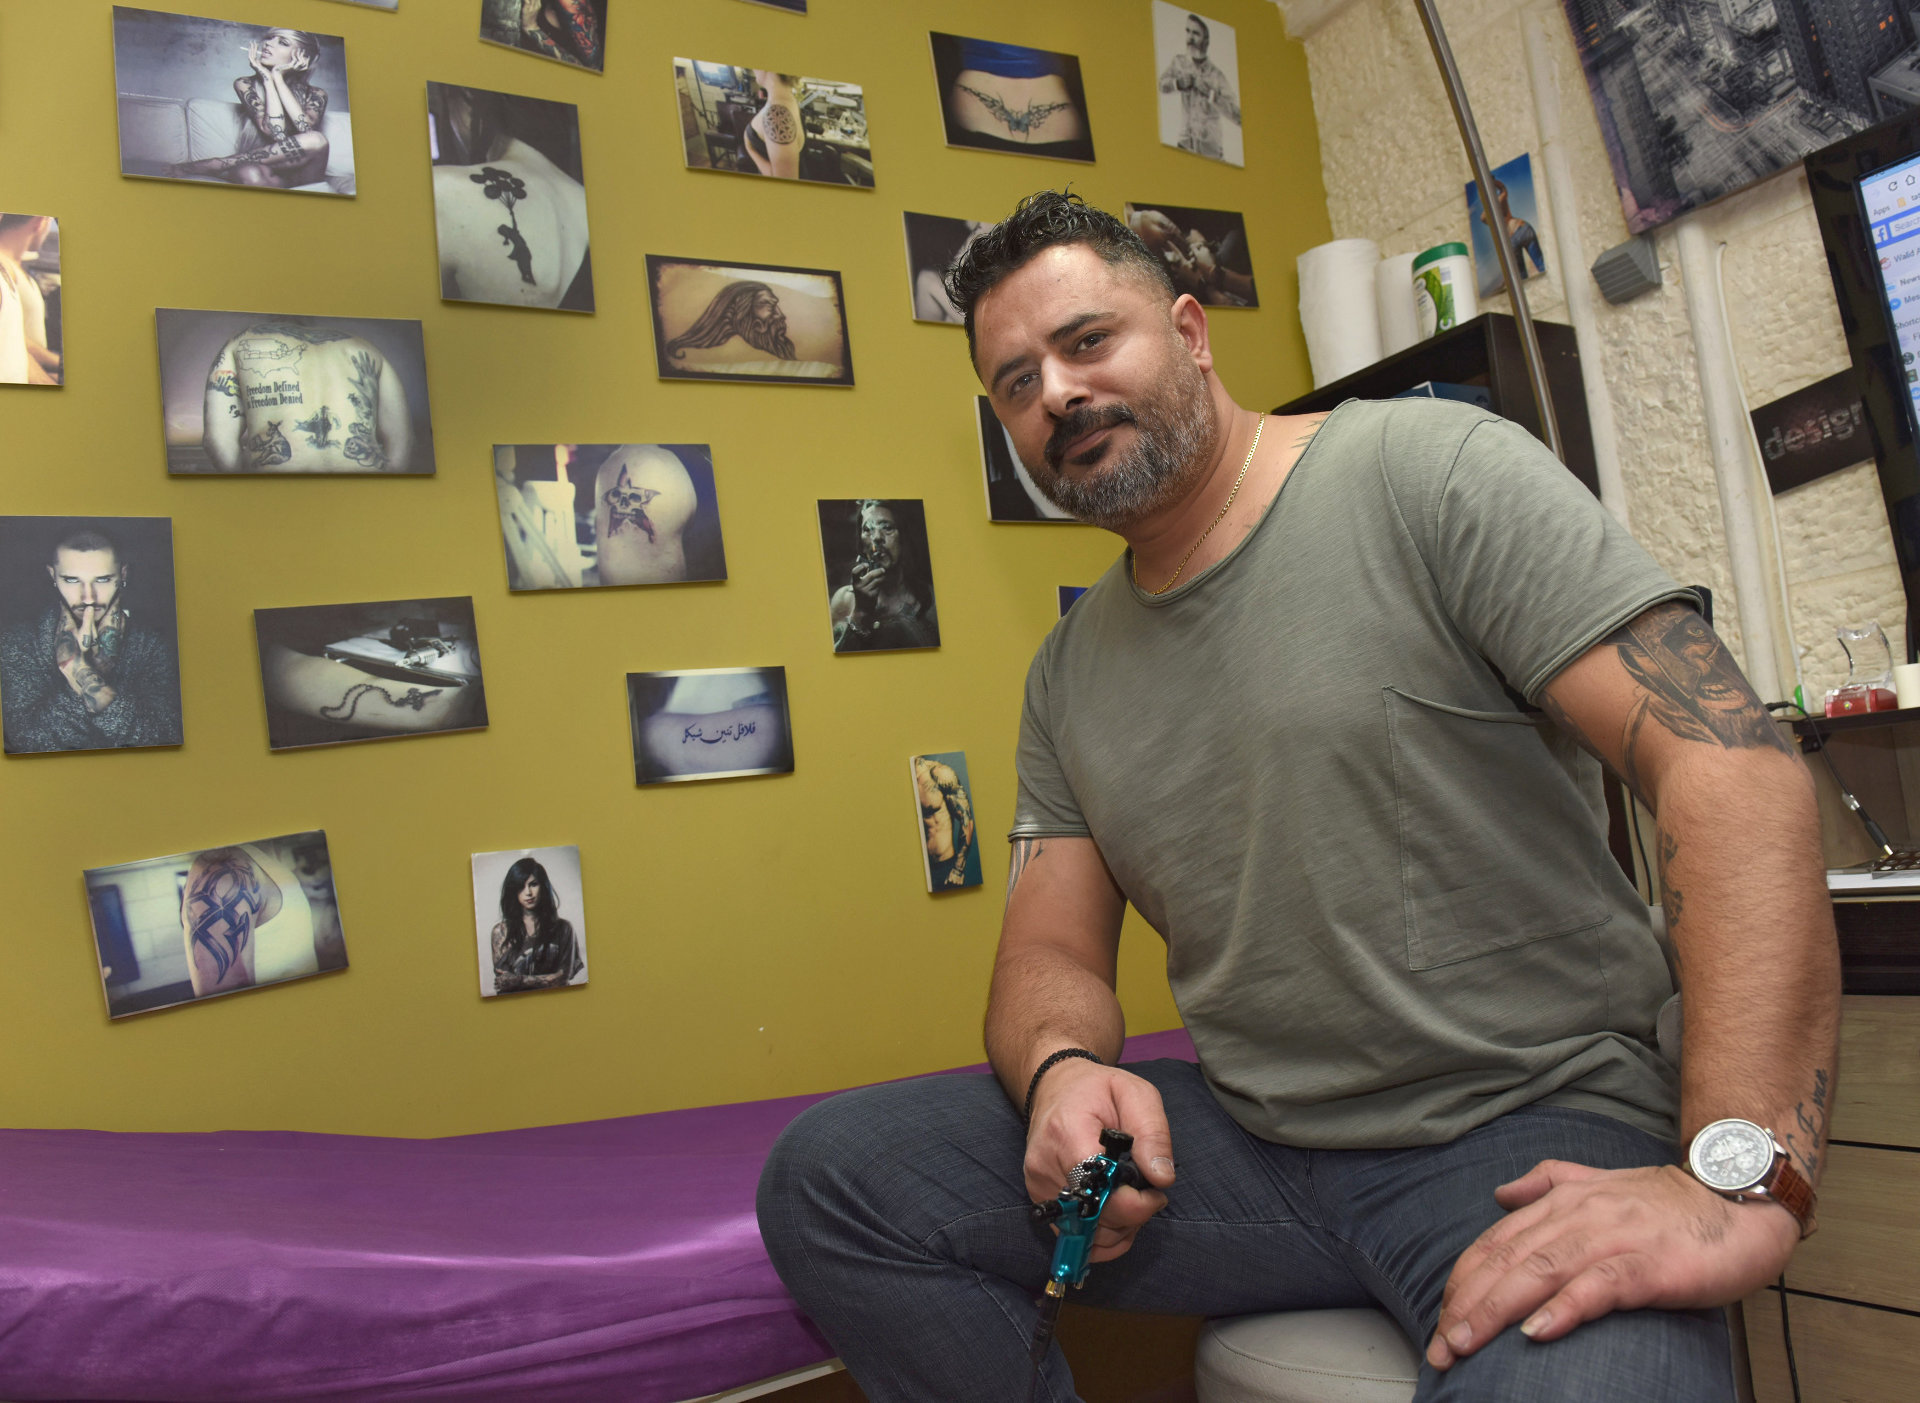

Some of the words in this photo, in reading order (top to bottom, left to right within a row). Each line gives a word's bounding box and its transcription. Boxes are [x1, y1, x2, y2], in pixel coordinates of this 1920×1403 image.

[273, 381, 300, 392] Defined
[251, 395, 278, 408] Freedom
[280, 392, 303, 405] Denied
